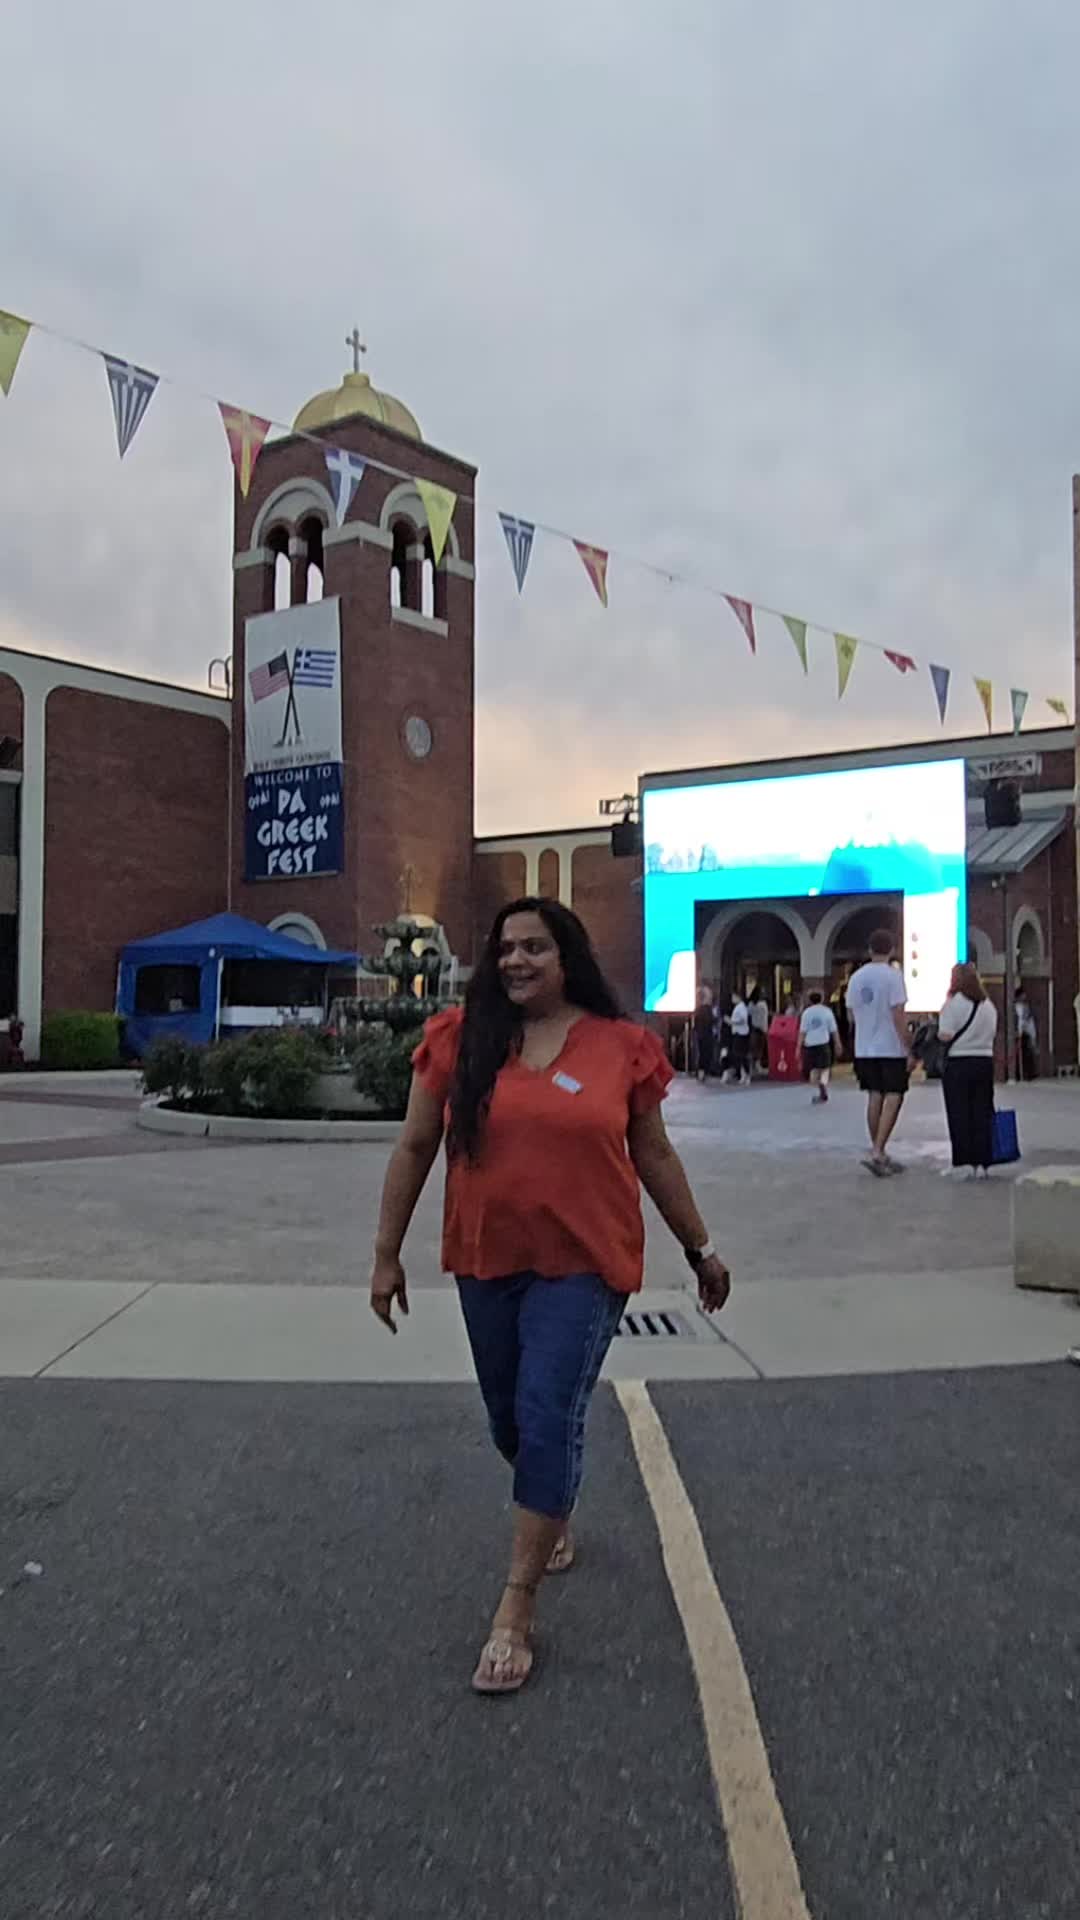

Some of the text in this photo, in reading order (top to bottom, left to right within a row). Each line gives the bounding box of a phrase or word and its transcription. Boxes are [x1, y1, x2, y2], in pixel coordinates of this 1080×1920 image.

[317, 765, 332, 779] TO
[278, 787, 306, 816] PA
[257, 814, 328, 846] GREEK
[268, 844, 317, 875] FEST
